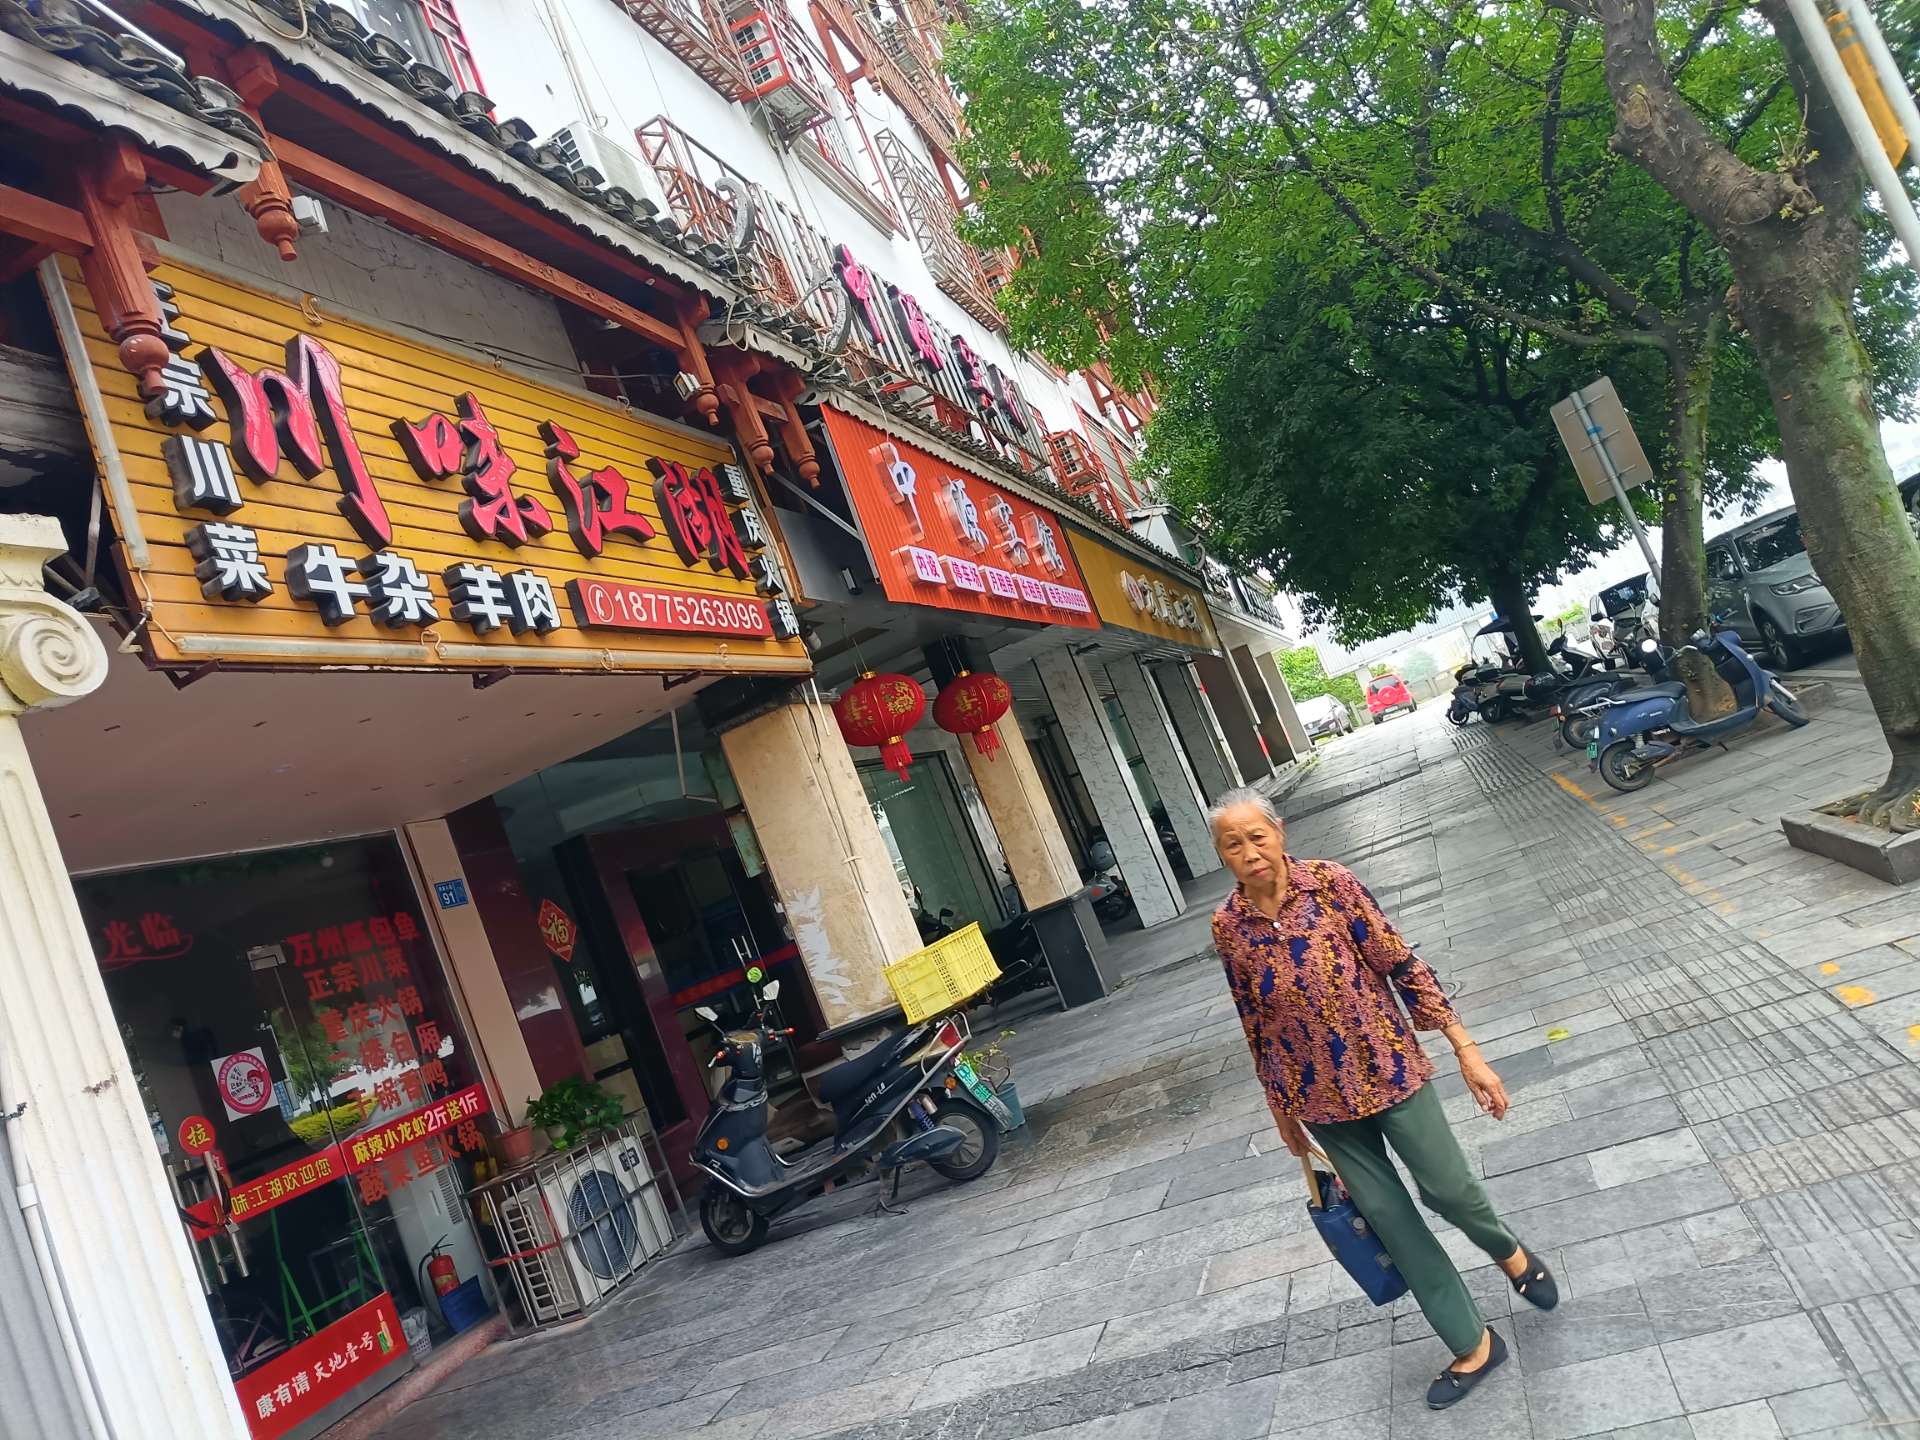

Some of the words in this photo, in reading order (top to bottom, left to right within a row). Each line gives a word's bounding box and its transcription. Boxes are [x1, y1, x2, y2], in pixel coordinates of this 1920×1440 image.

[203, 334, 749, 580] 川味江湖
[723, 463, 800, 636] 重庆火锅
[303, 544, 559, 630] 牛杂羊肉
[614, 588, 764, 631] 18775263096
[442, 891, 456, 904] 91
[542, 912, 569, 945] 福
[304, 949, 409, 1000] 正宗川菜
[318, 985, 424, 1046] 重庆火锅
[187, 1123, 211, 1149] 拉
[351, 1090, 479, 1165] 麻辣小龙虾2斤送1斤
